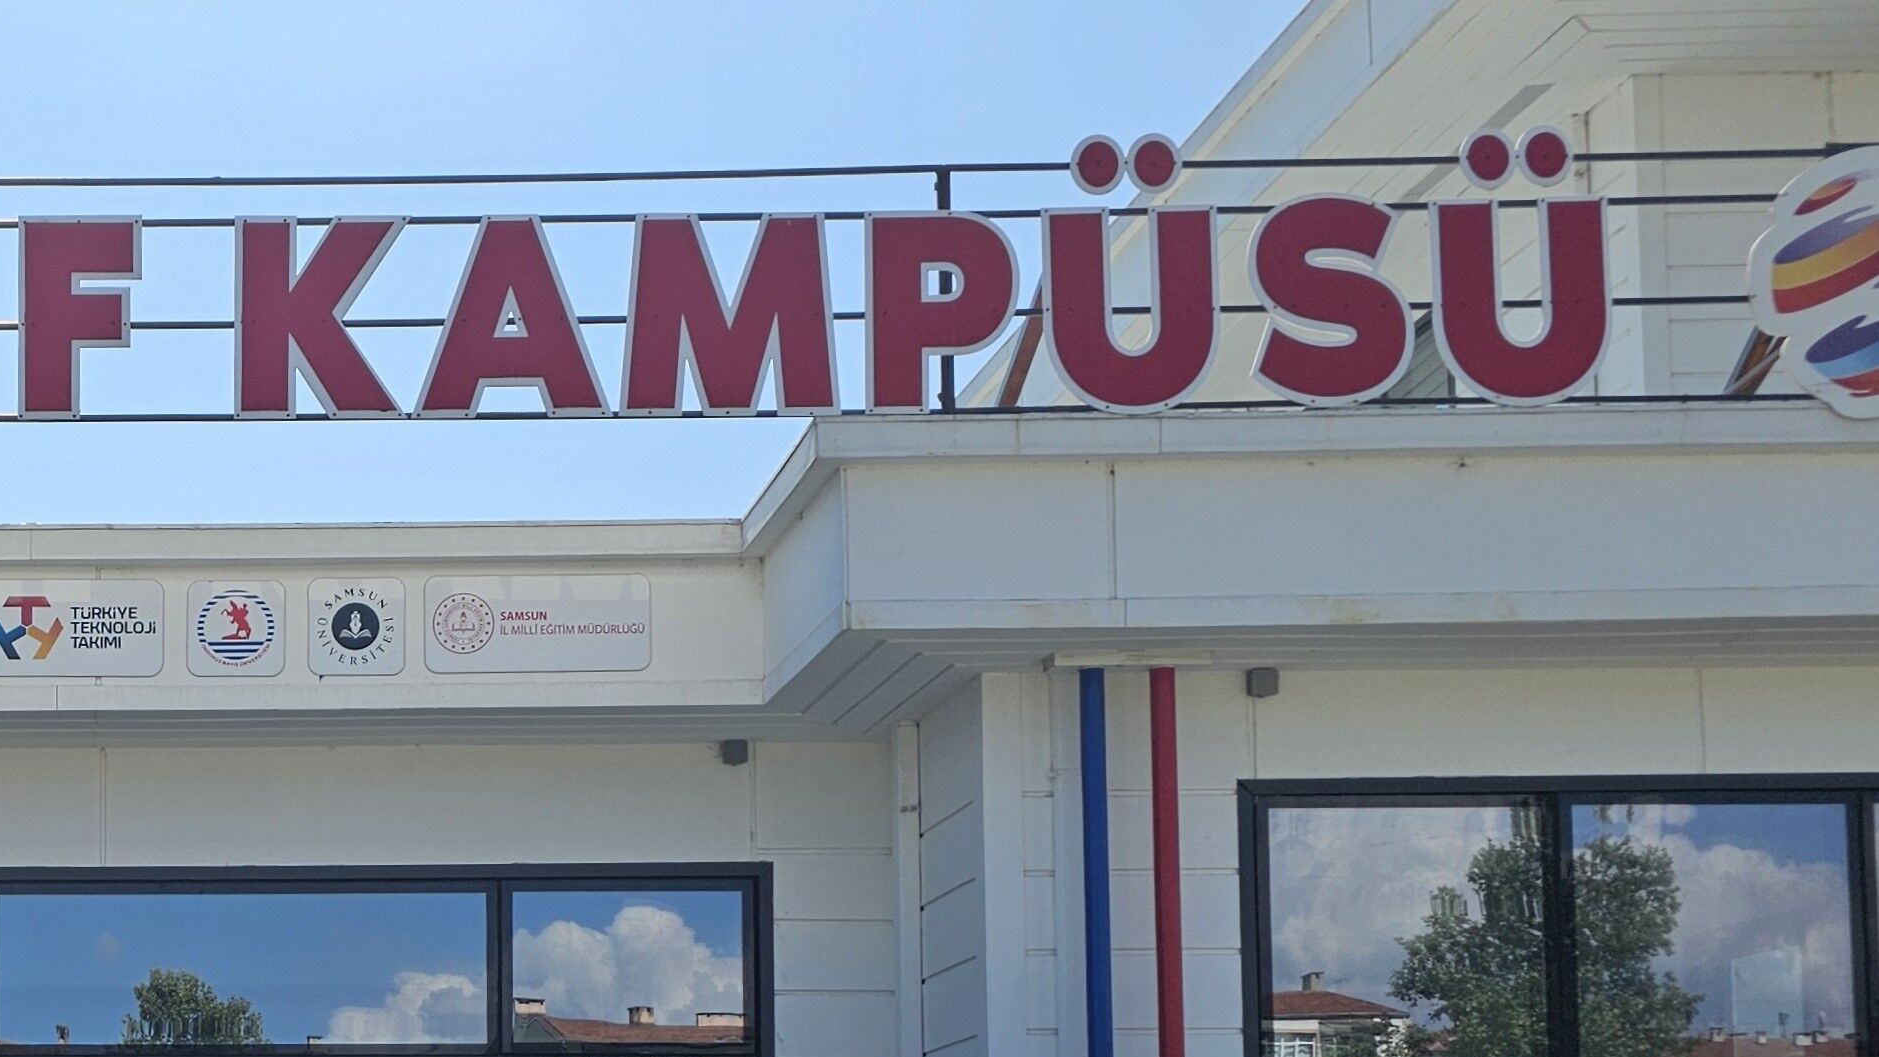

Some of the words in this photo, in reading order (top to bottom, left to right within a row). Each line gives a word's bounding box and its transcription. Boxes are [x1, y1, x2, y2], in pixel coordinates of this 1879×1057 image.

[233, 125, 1613, 416] KAMPÜSÜ
[324, 588, 388, 610] SAMSUN
[500, 611, 547, 621] SAMSUN
[500, 623, 509, 635] İL
[510, 622, 538, 635] MİLLİ
[540, 620, 574, 634] EĞİTİM
[577, 621, 645, 634] MÜDÜRLÜĞÜ
[70, 636, 122, 649] TAKIMI
